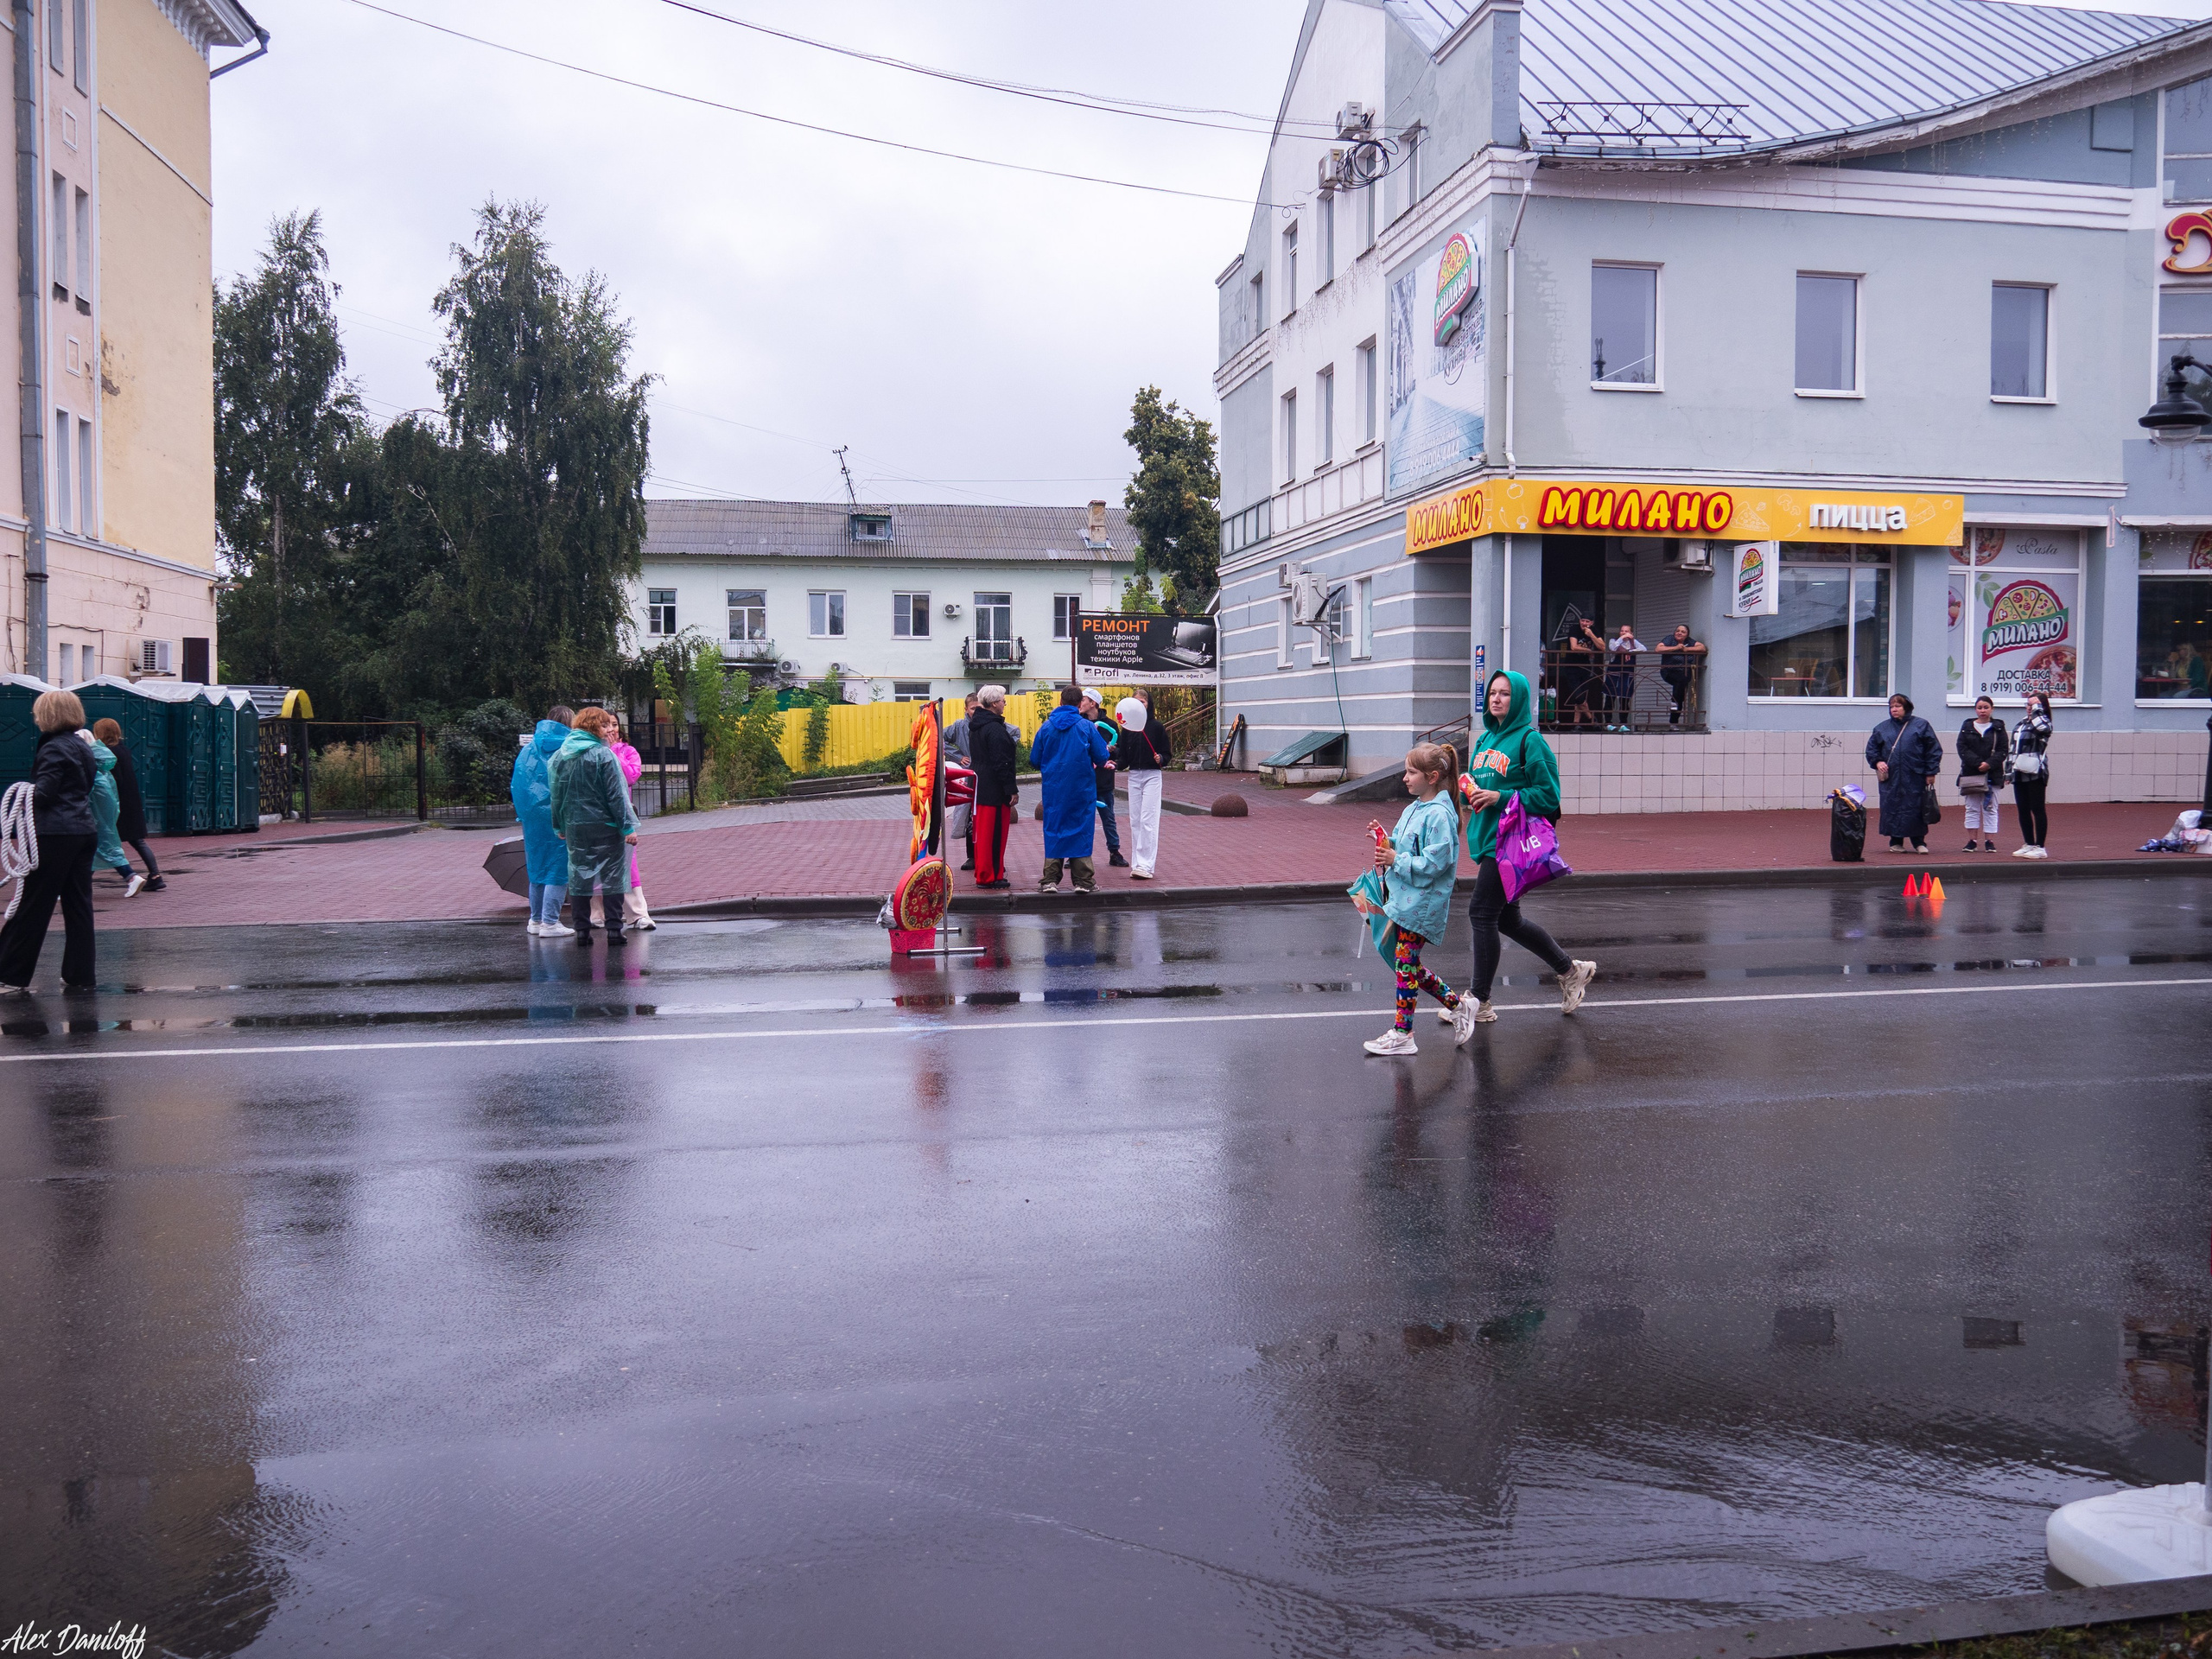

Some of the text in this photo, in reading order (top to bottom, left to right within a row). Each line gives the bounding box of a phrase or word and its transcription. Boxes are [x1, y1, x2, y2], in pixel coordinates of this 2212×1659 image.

[1538, 486, 1733, 533] МИЛАНО
[1414, 490, 1483, 547] МИЛАНО
[1809, 504, 1908, 532] пицца
[2016, 537, 2058, 555] Pasta
[1082, 619, 1151, 633] РЕМОНТ
[1094, 633, 1141, 642] смартфонов
[1986, 615, 2064, 654] МИЛАНО
[1097, 648, 1136, 657] ноутбуков
[1122, 656, 1143, 664] Apple
[1094, 668, 1119, 677] Profi
[1997, 670, 2051, 682] ДОСТАВКА
[1980, 683, 2067, 693] 8 (919) 006-44-44
[1519, 835, 1541, 853] WB
